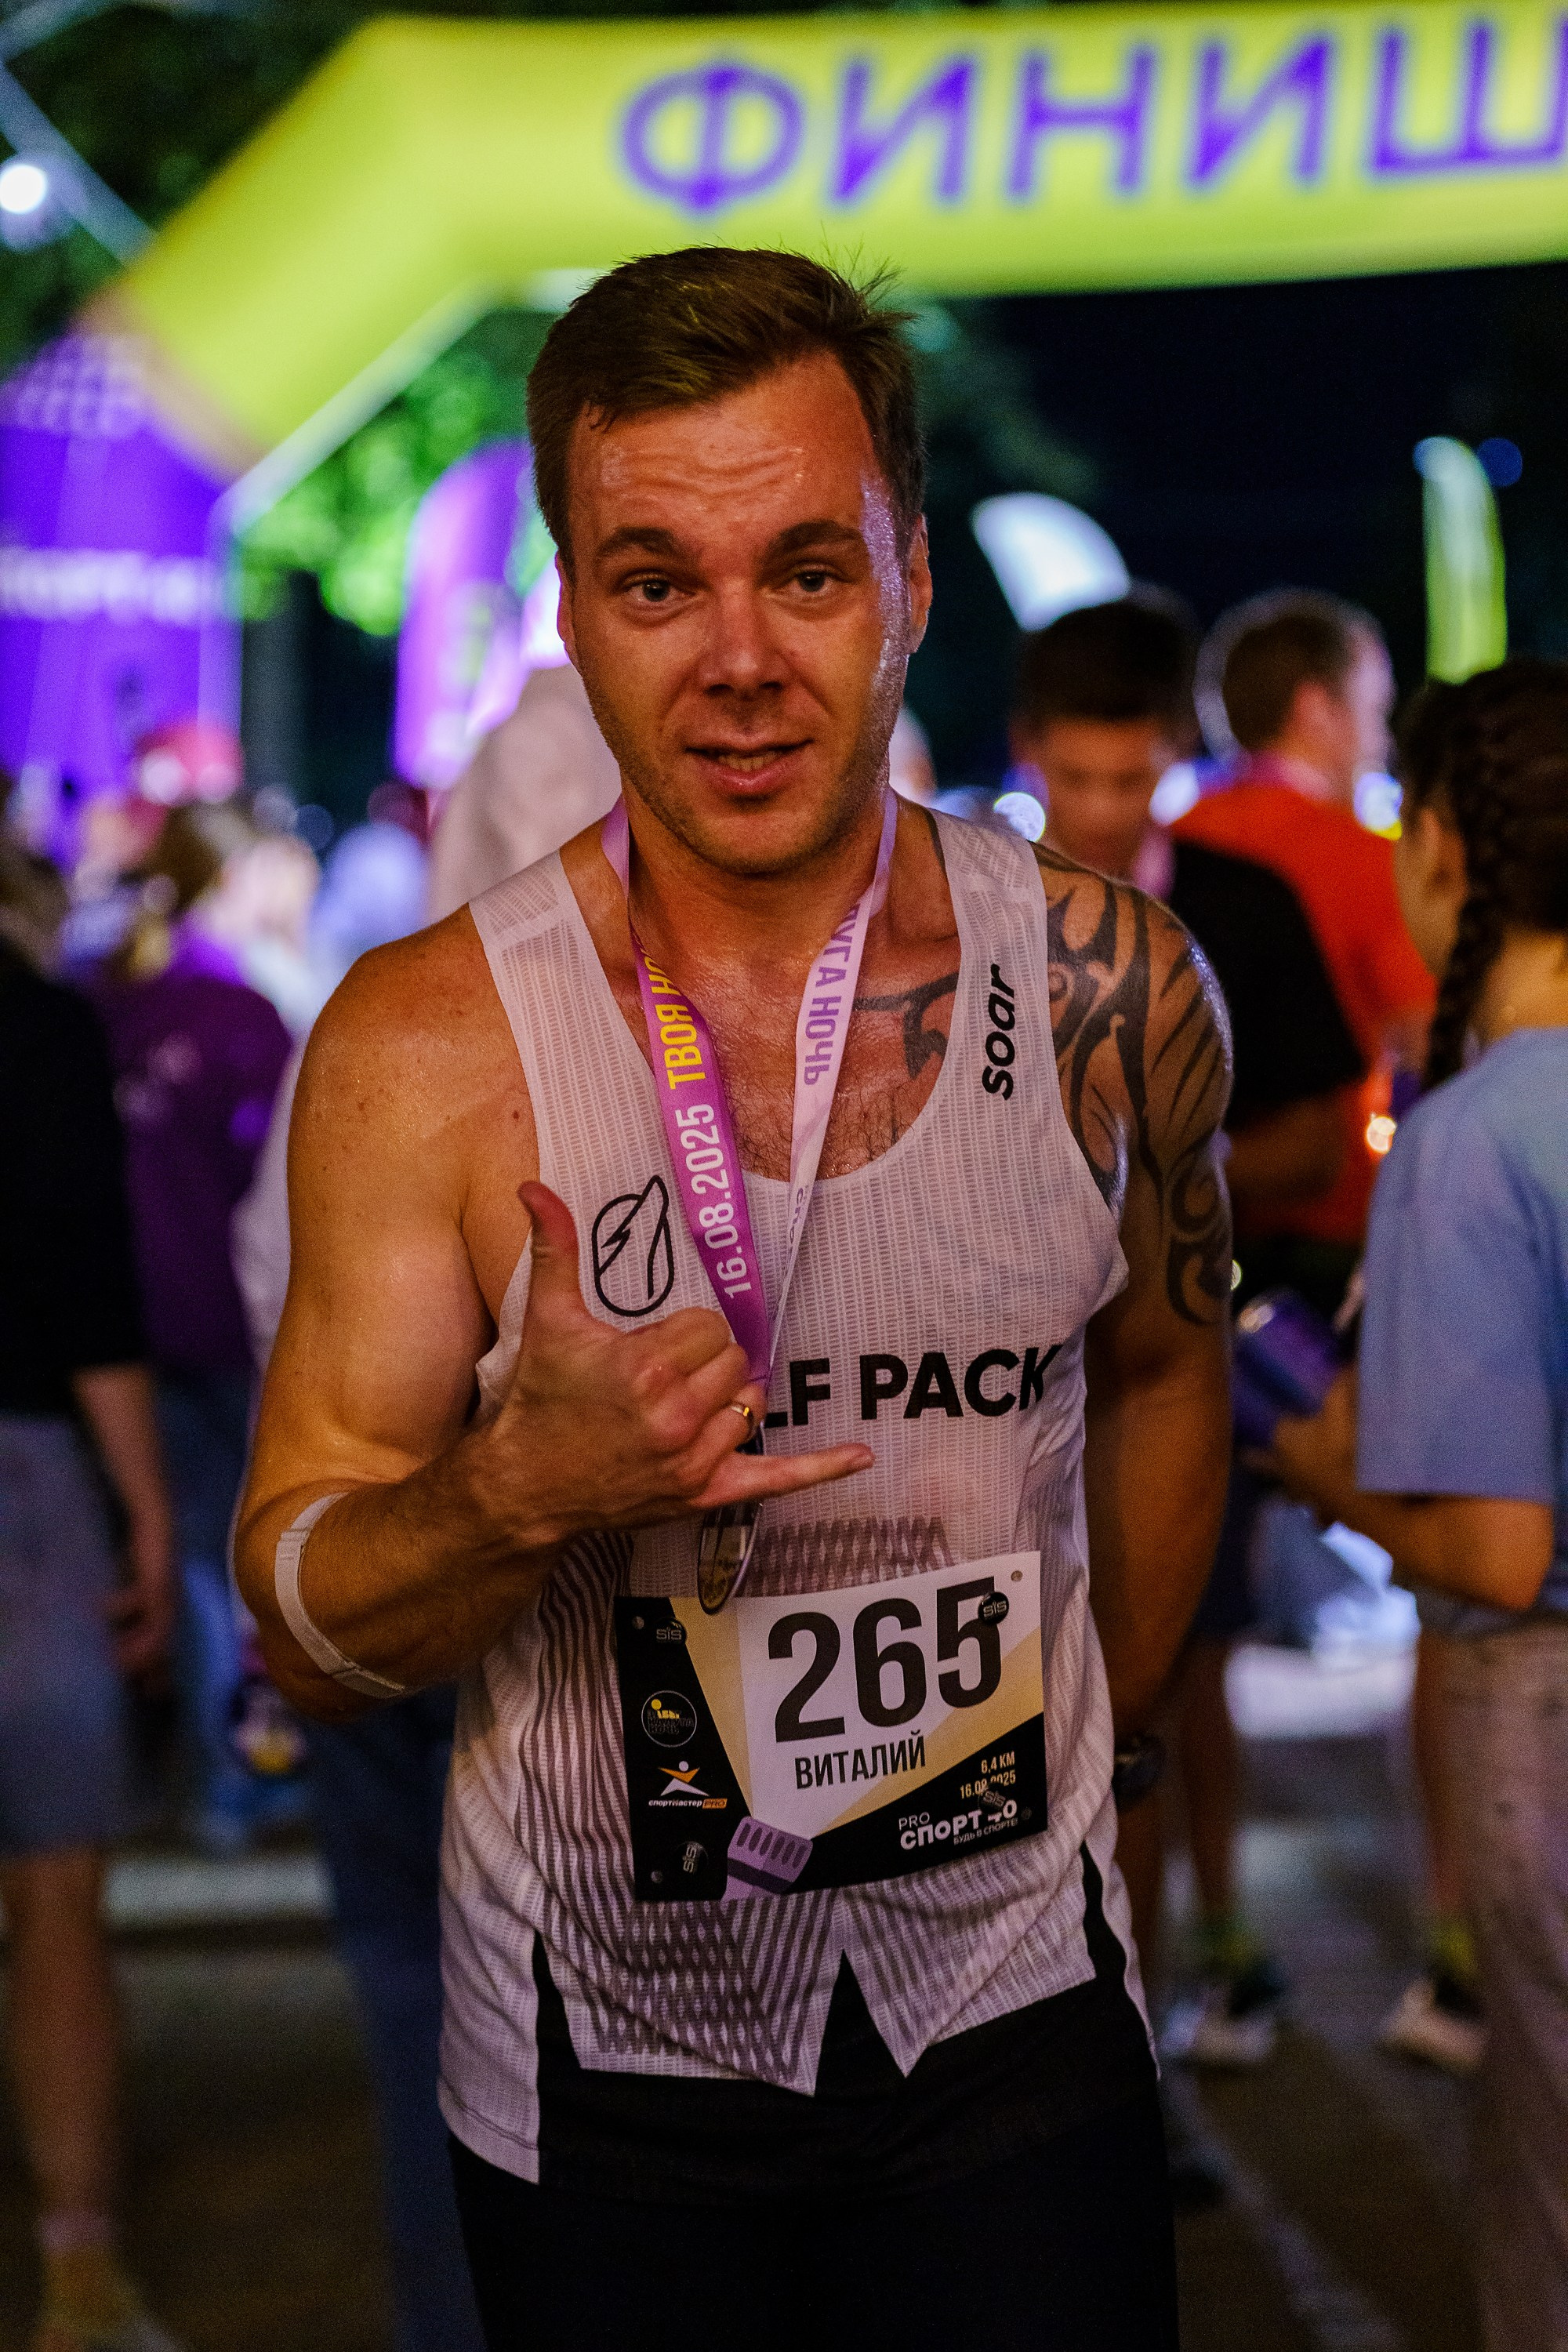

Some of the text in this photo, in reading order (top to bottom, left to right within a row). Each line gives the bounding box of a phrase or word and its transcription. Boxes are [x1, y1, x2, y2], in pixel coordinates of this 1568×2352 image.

[619, 17, 1568, 216] ФИНИШ
[640, 948, 706, 1091] ТВОЯ НО
[804, 996, 842, 1086] НОЧЬ
[982, 964, 1015, 1101] soar
[675, 1103, 753, 1299] 16.08.2025
[764, 1344, 1065, 1428] F PACK
[768, 1576, 1002, 1744] 265
[794, 1729, 927, 1790] ВИТАЛИЙ
[898, 1811, 931, 1831] PRO
[900, 1809, 982, 1850] СПОРТ
